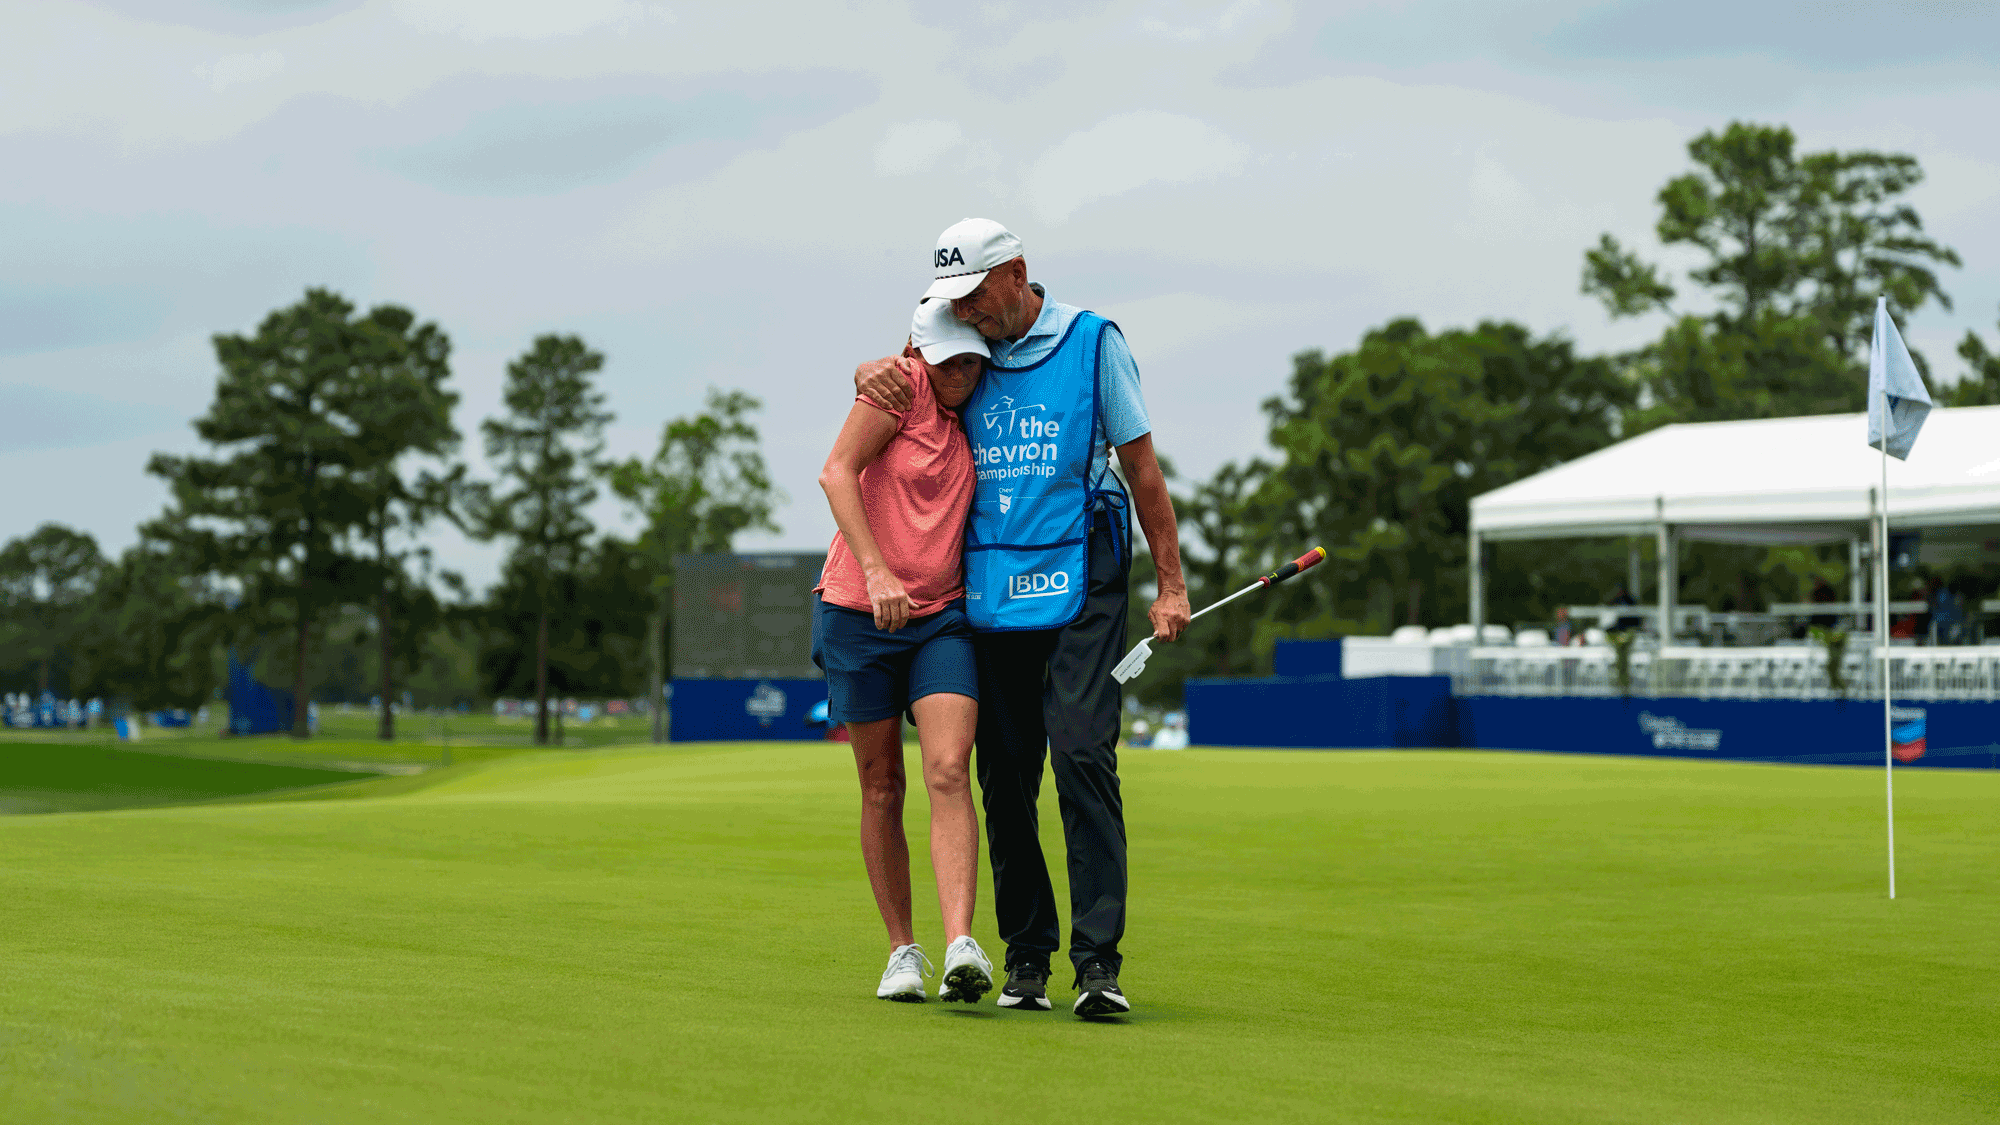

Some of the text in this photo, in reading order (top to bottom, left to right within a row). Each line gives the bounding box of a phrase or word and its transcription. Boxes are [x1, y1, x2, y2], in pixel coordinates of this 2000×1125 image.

[934, 247, 965, 268] USA
[1020, 416, 1059, 439] the
[977, 463, 1056, 481] ampioship
[1016, 571, 1069, 593] BDO
